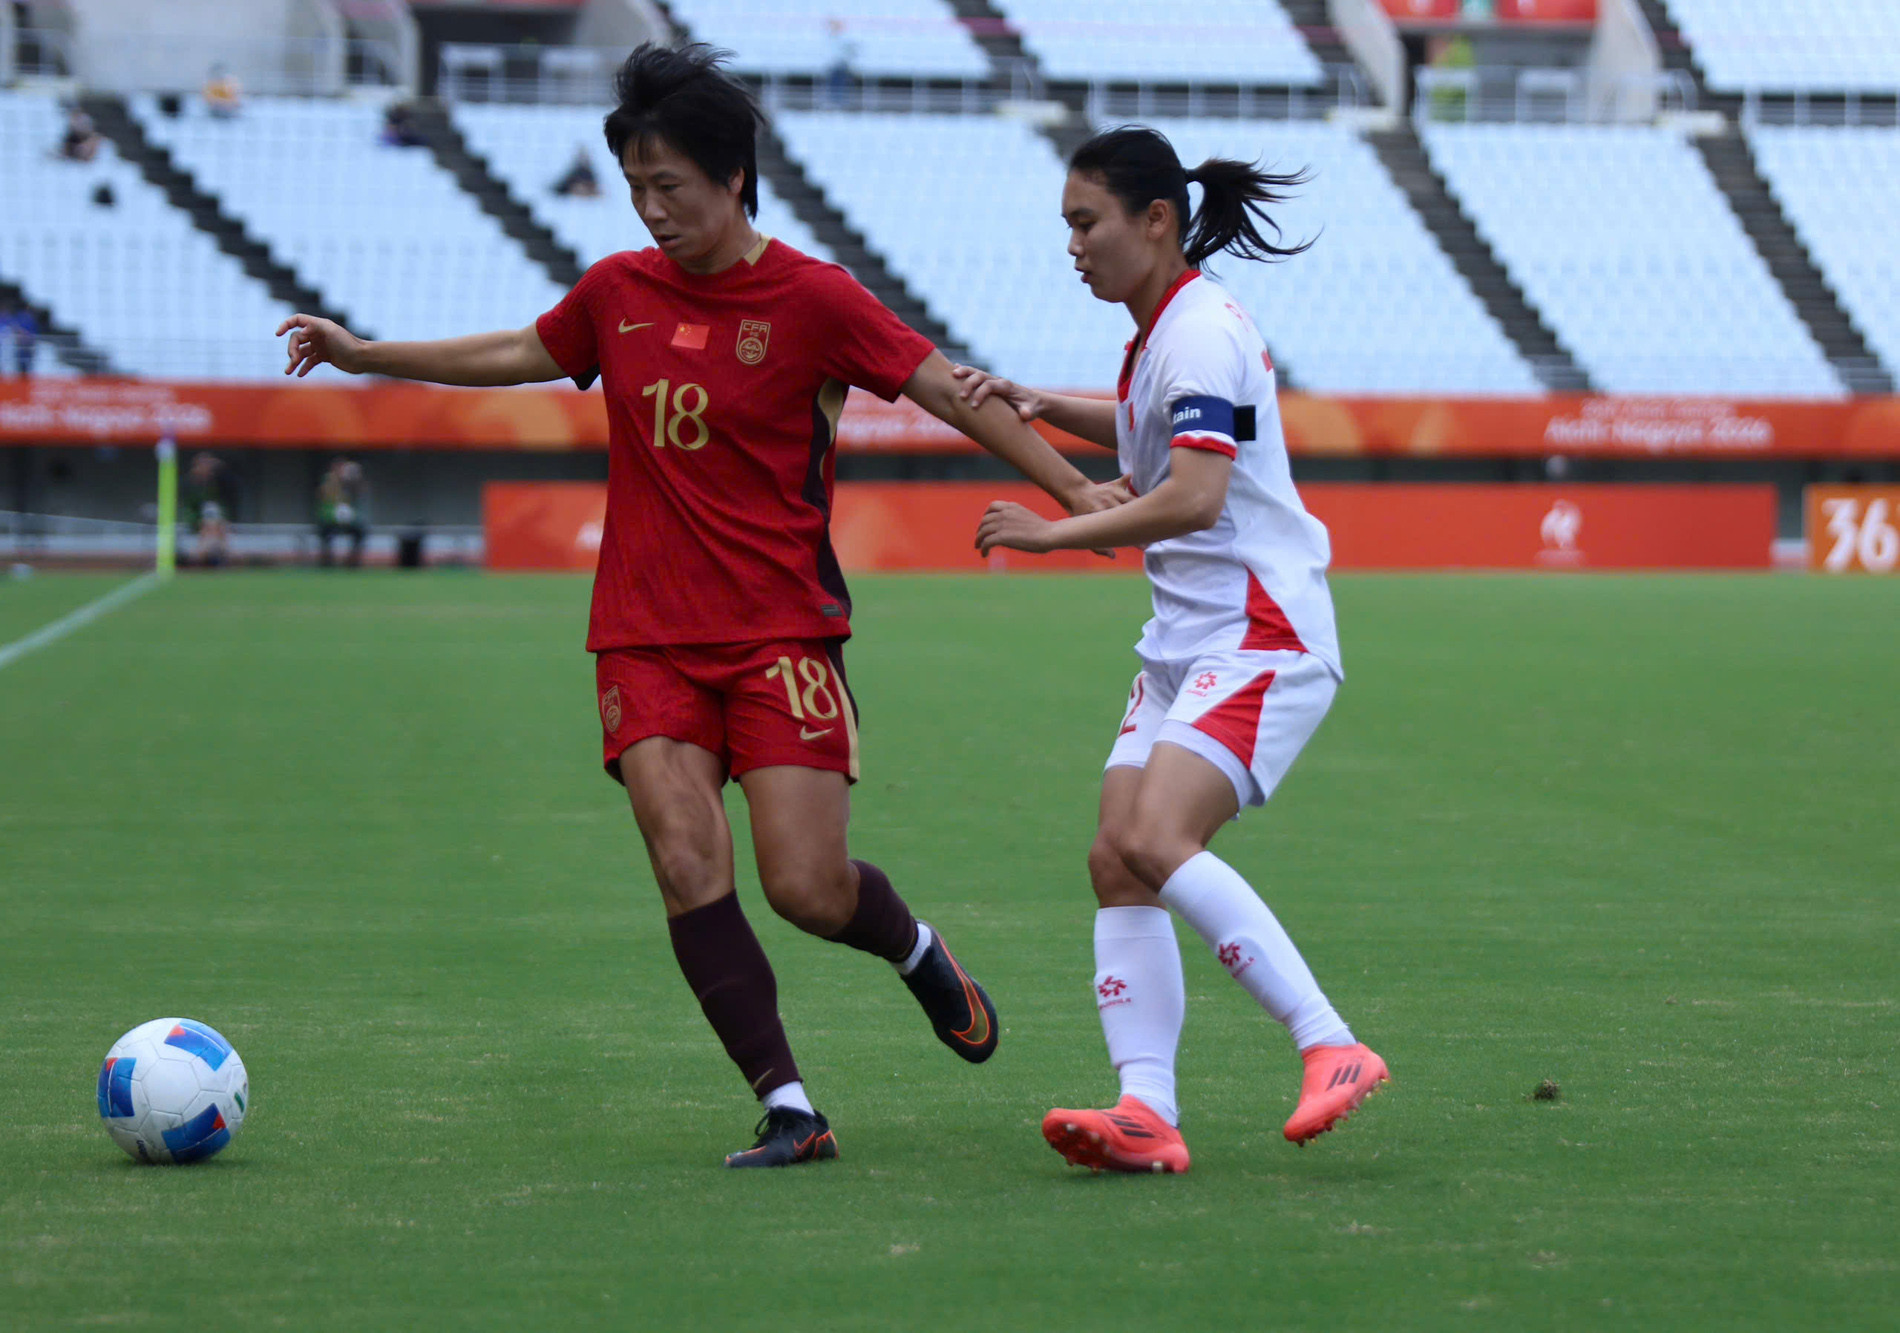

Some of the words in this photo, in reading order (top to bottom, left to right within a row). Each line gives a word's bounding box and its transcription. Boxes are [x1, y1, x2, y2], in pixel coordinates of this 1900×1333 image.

[743, 322, 768, 333] CFA
[642, 378, 710, 450] 18
[1822, 498, 1900, 571] 36
[765, 656, 838, 719] 18
